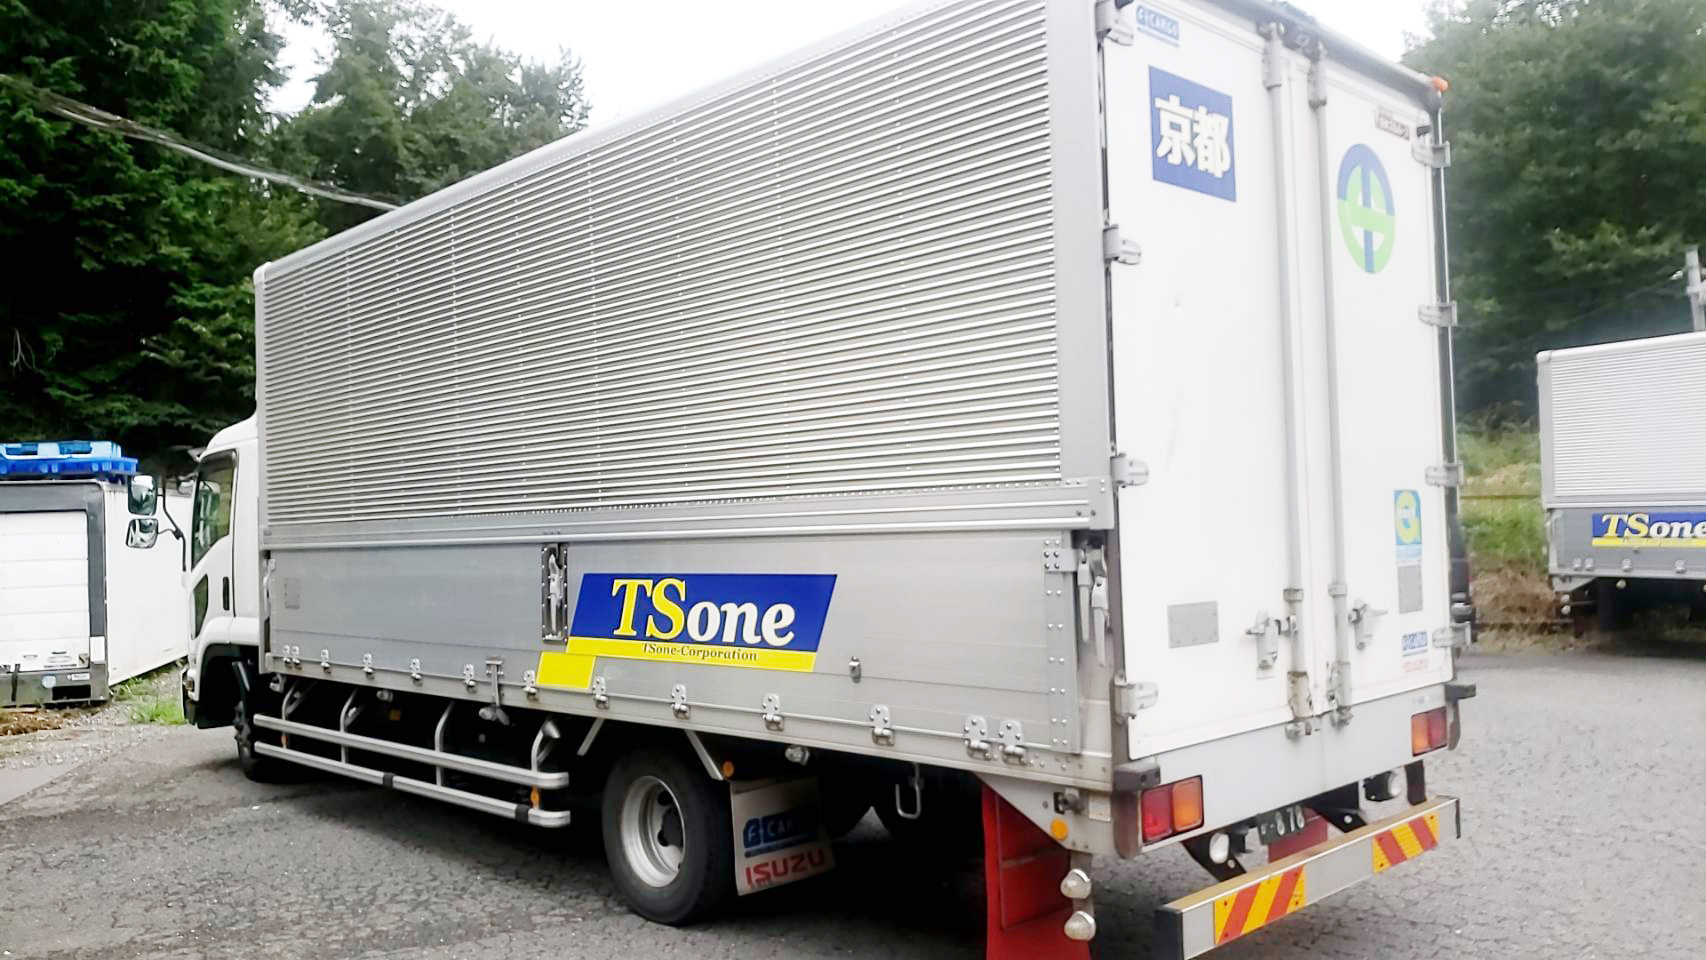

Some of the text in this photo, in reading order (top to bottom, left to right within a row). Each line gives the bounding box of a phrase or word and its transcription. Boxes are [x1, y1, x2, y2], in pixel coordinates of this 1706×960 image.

[1154, 93, 1232, 179] 京都
[1601, 512, 1706, 540] TSone
[611, 577, 796, 648] TSone
[642, 643, 758, 661] TSone-Corporation
[744, 847, 826, 888] ISUZU
